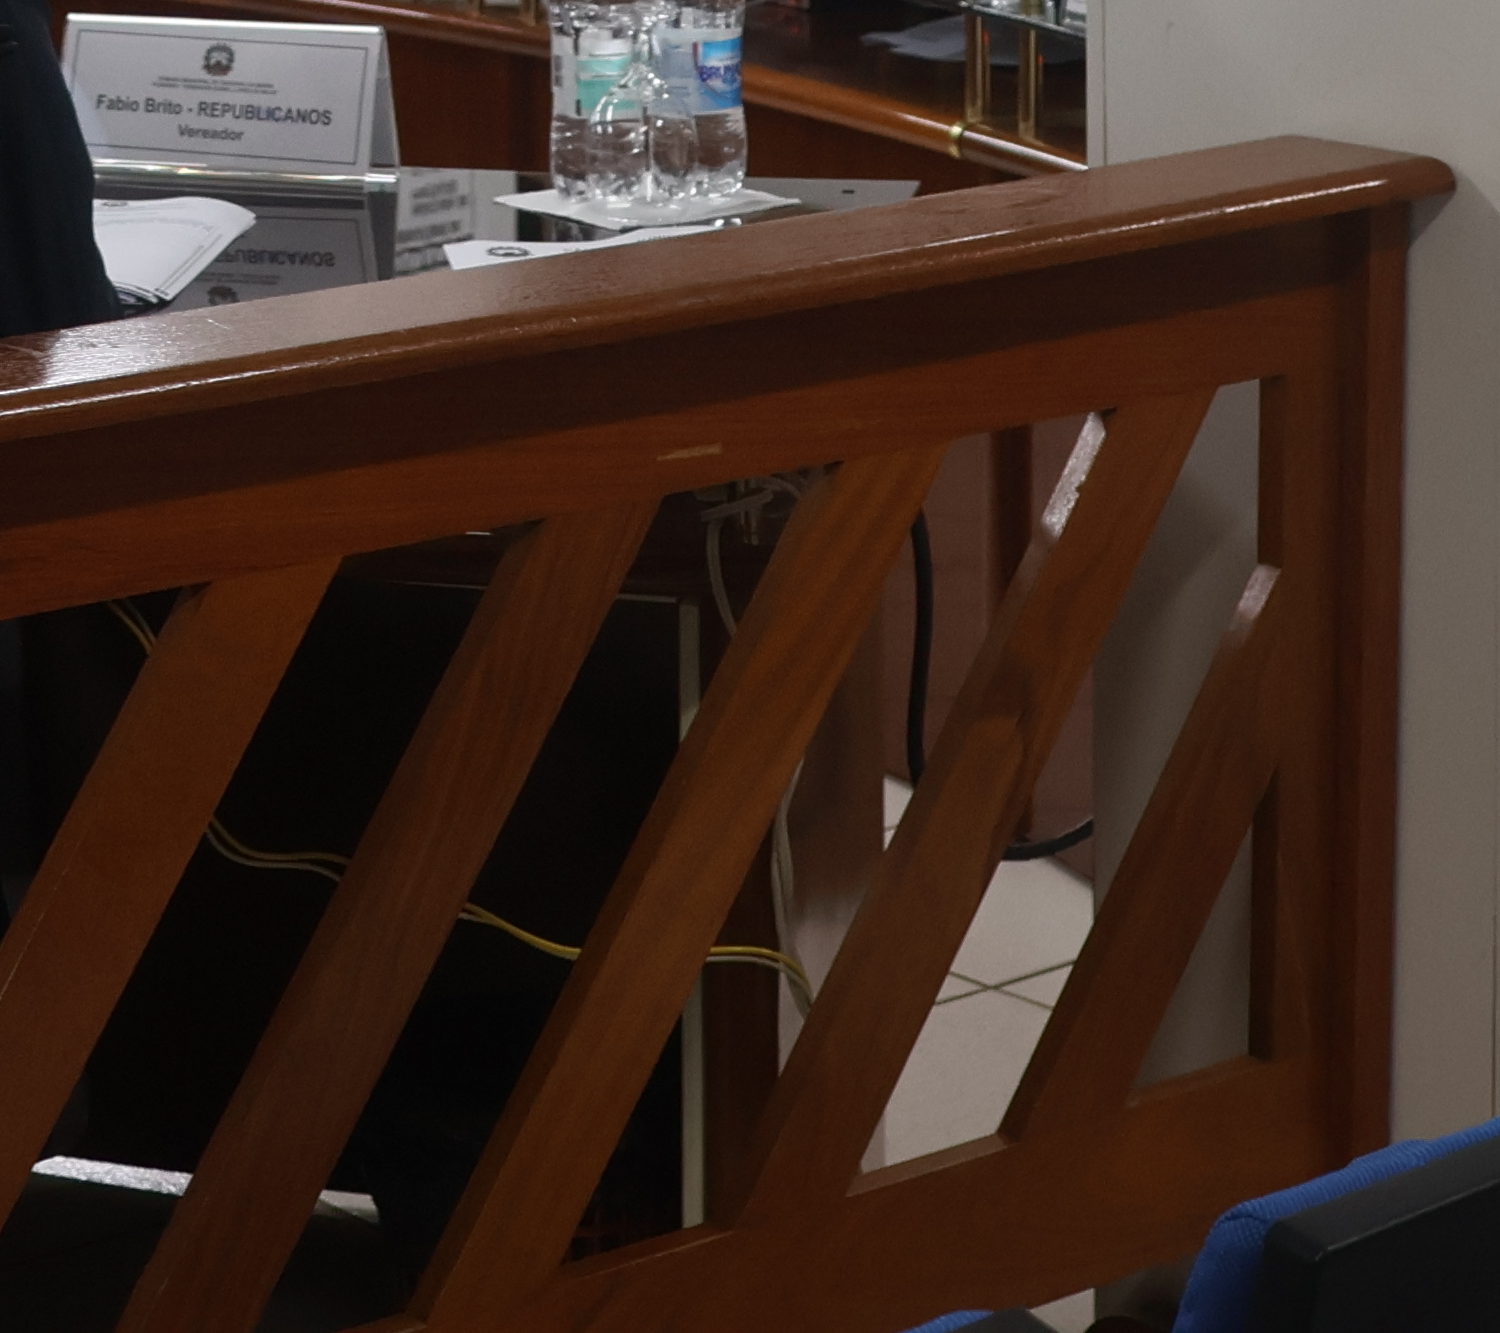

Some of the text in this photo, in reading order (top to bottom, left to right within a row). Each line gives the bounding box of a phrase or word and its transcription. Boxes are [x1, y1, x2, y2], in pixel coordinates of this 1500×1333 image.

[96, 94, 140, 114] Fabio
[145, 97, 183, 116] Brito
[197, 101, 333, 126] REPUBLICANOS
[177, 124, 245, 142] Vereador
